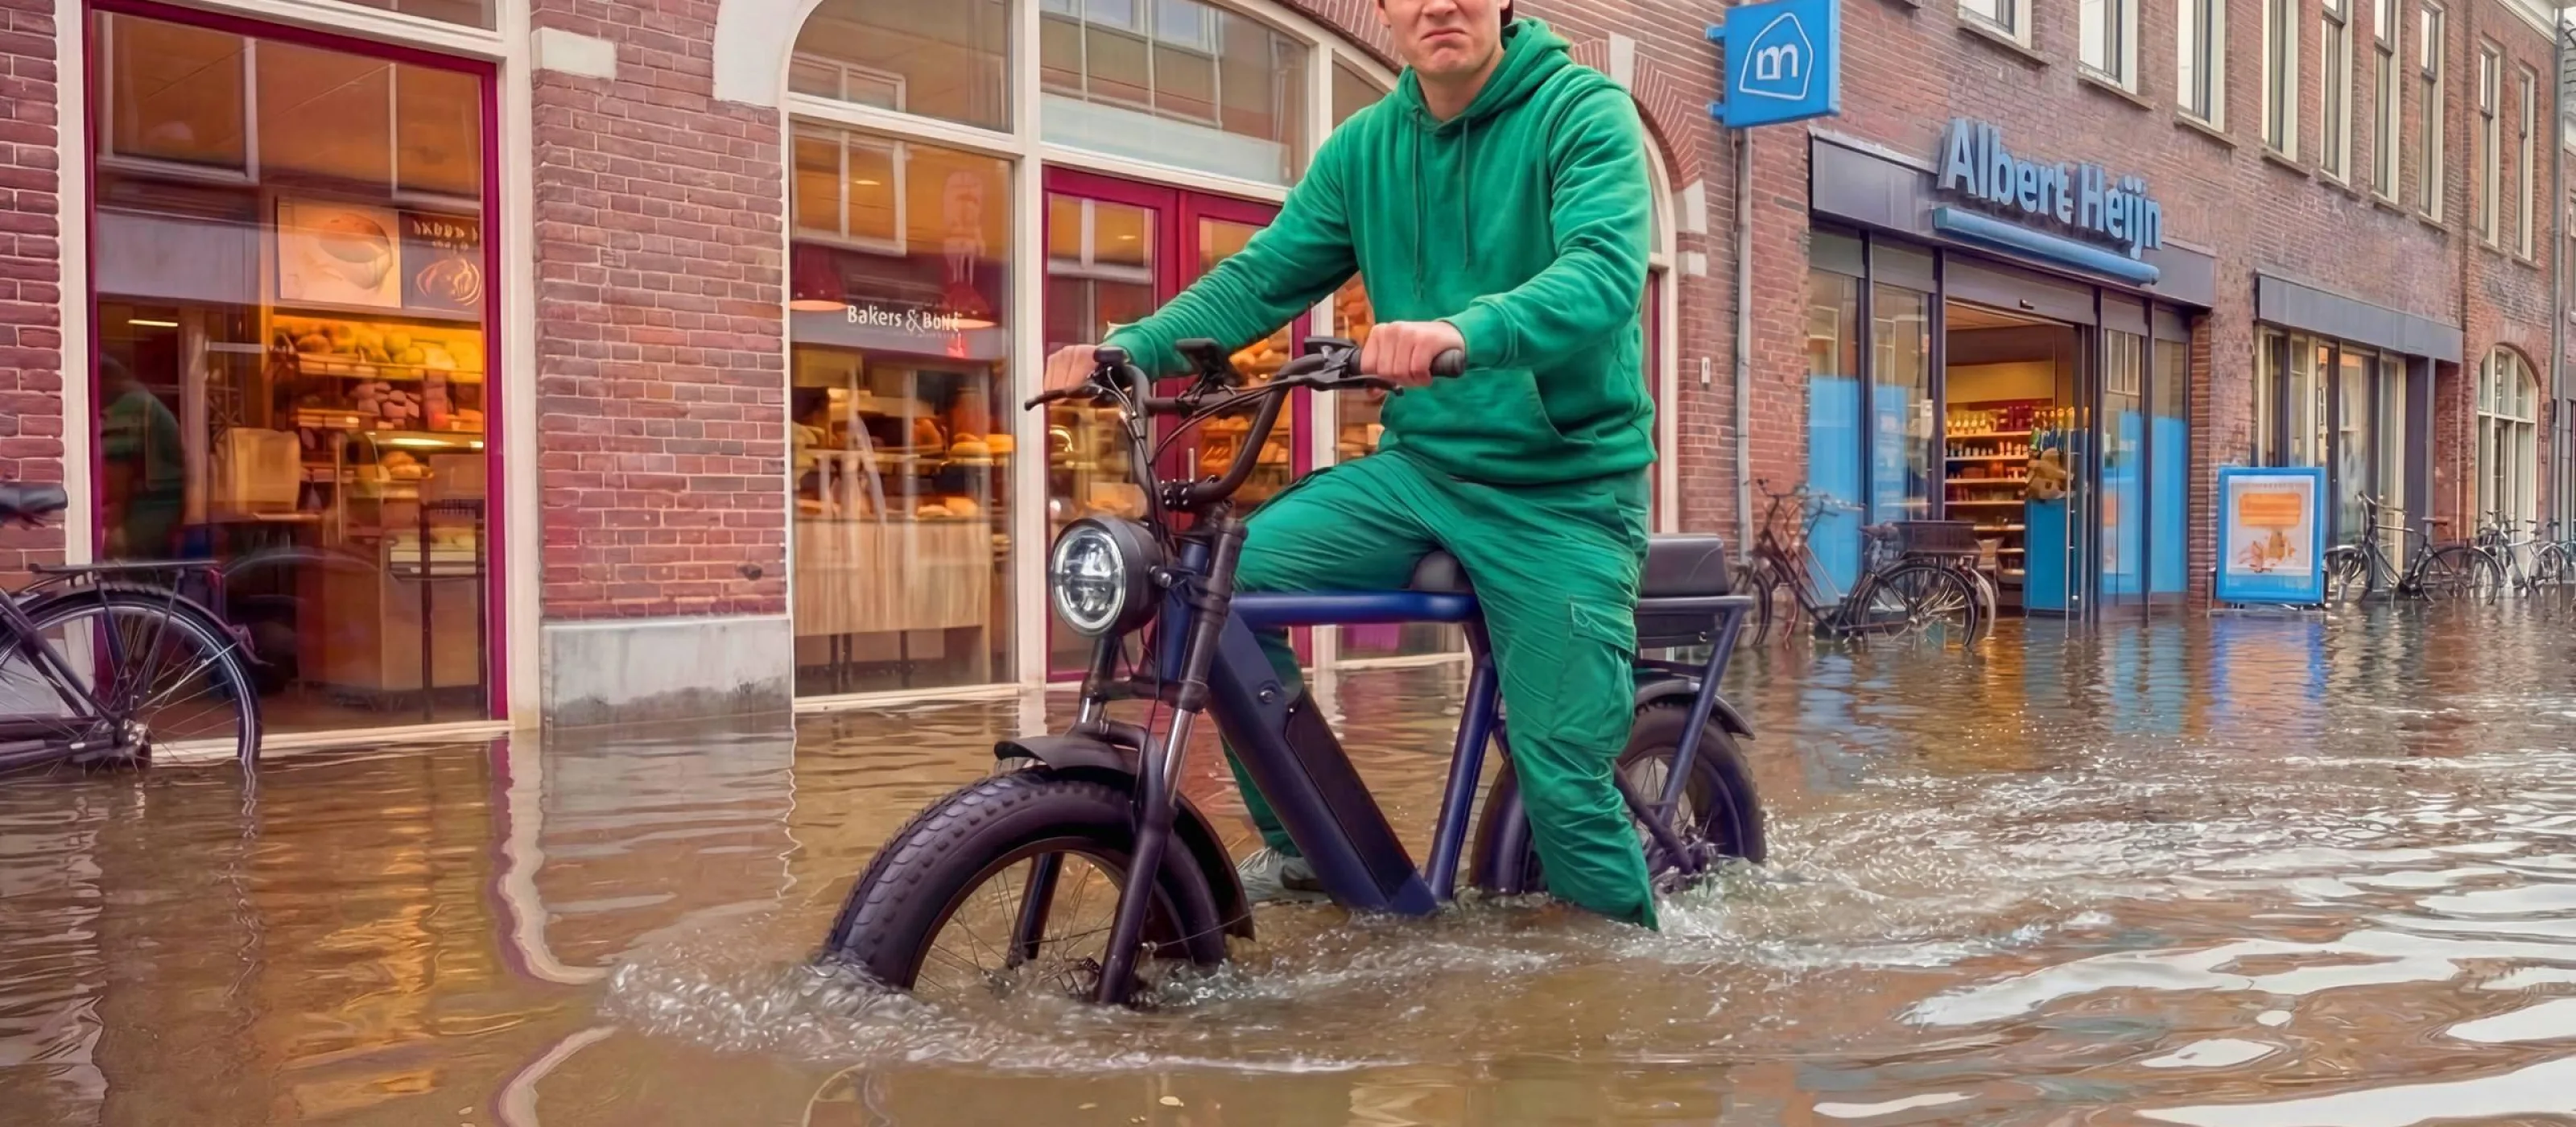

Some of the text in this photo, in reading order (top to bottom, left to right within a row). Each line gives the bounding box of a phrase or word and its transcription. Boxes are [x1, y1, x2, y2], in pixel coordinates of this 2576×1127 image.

[1938, 117, 2162, 260] Albert Heijn
[848, 305, 902, 327] Bakers
[906, 309, 925, 332] &
